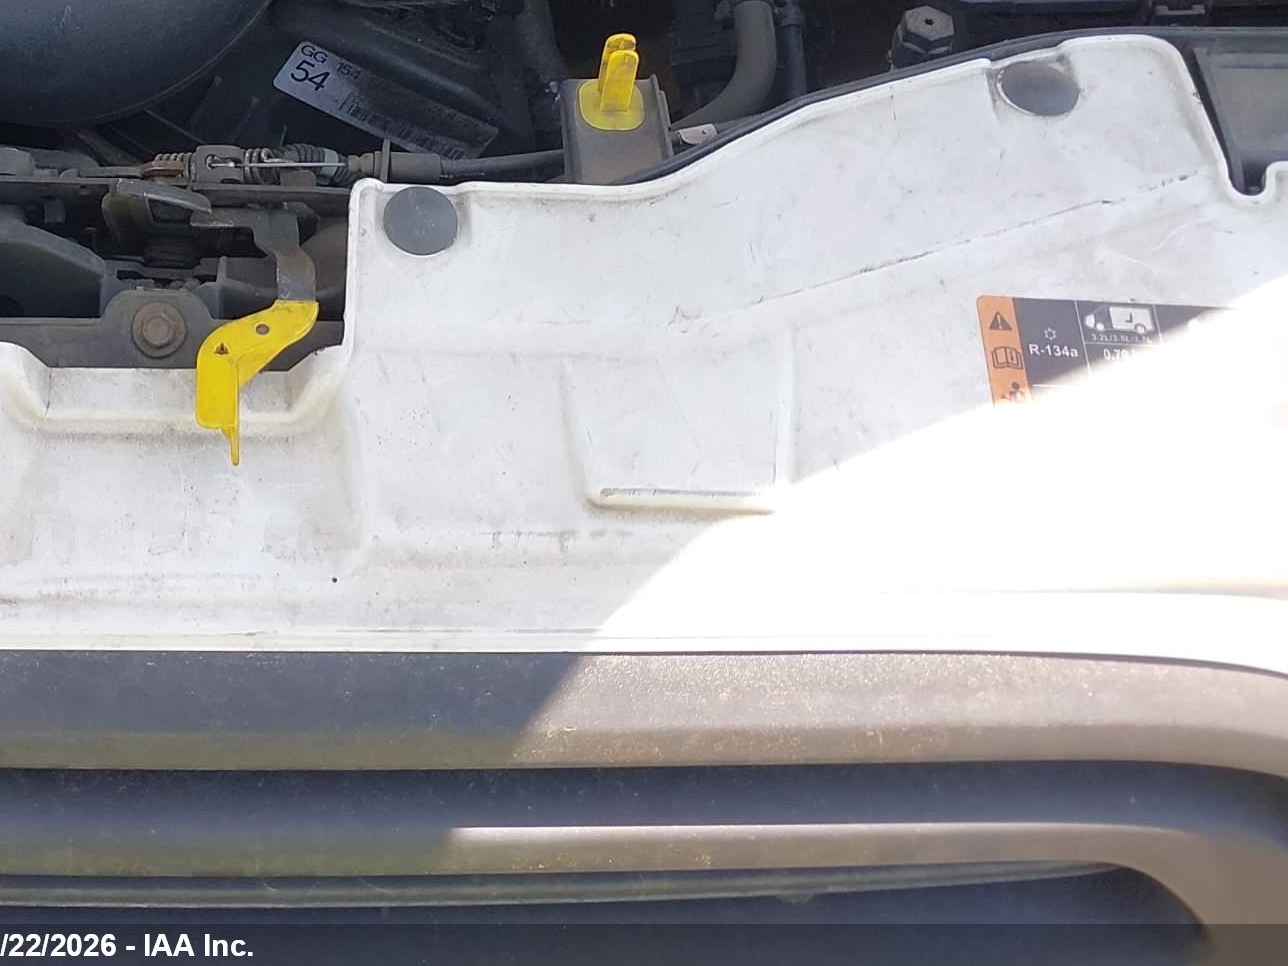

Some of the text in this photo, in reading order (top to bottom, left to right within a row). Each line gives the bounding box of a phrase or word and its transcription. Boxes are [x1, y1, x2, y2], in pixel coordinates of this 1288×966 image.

[301, 45, 328, 63] GG
[291, 60, 330, 90] 54
[1029, 344, 1078, 357] R-134a
